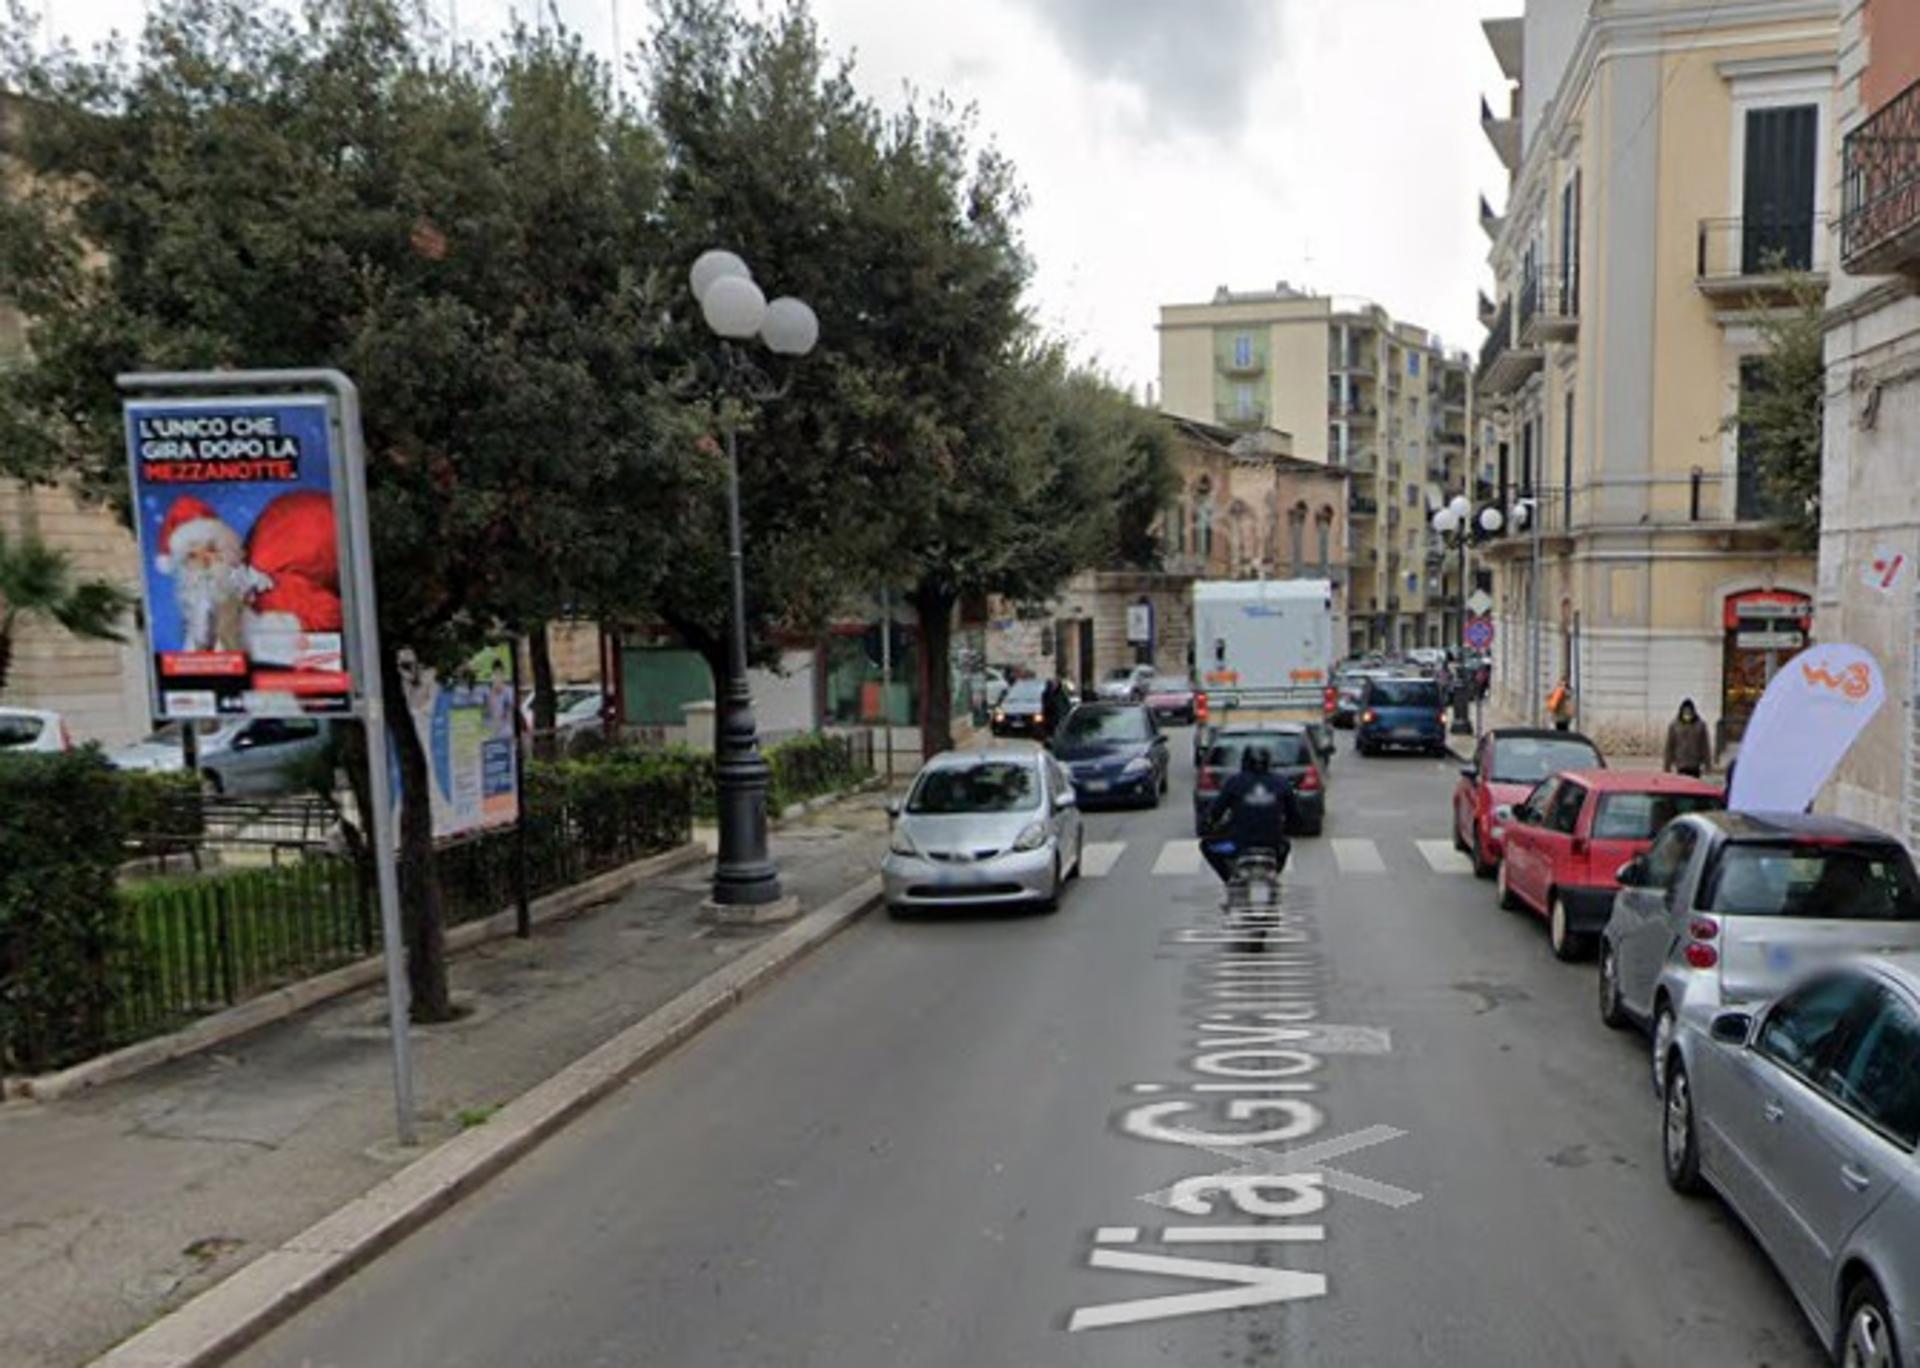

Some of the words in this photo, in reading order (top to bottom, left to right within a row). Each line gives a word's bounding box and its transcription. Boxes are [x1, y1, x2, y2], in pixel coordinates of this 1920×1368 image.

[140, 418, 227, 438] L'UNICO
[231, 416, 276, 436] CHE
[142, 440, 195, 460] GIRA
[200, 439, 263, 459] DOPO
[266, 438, 298, 458] LA
